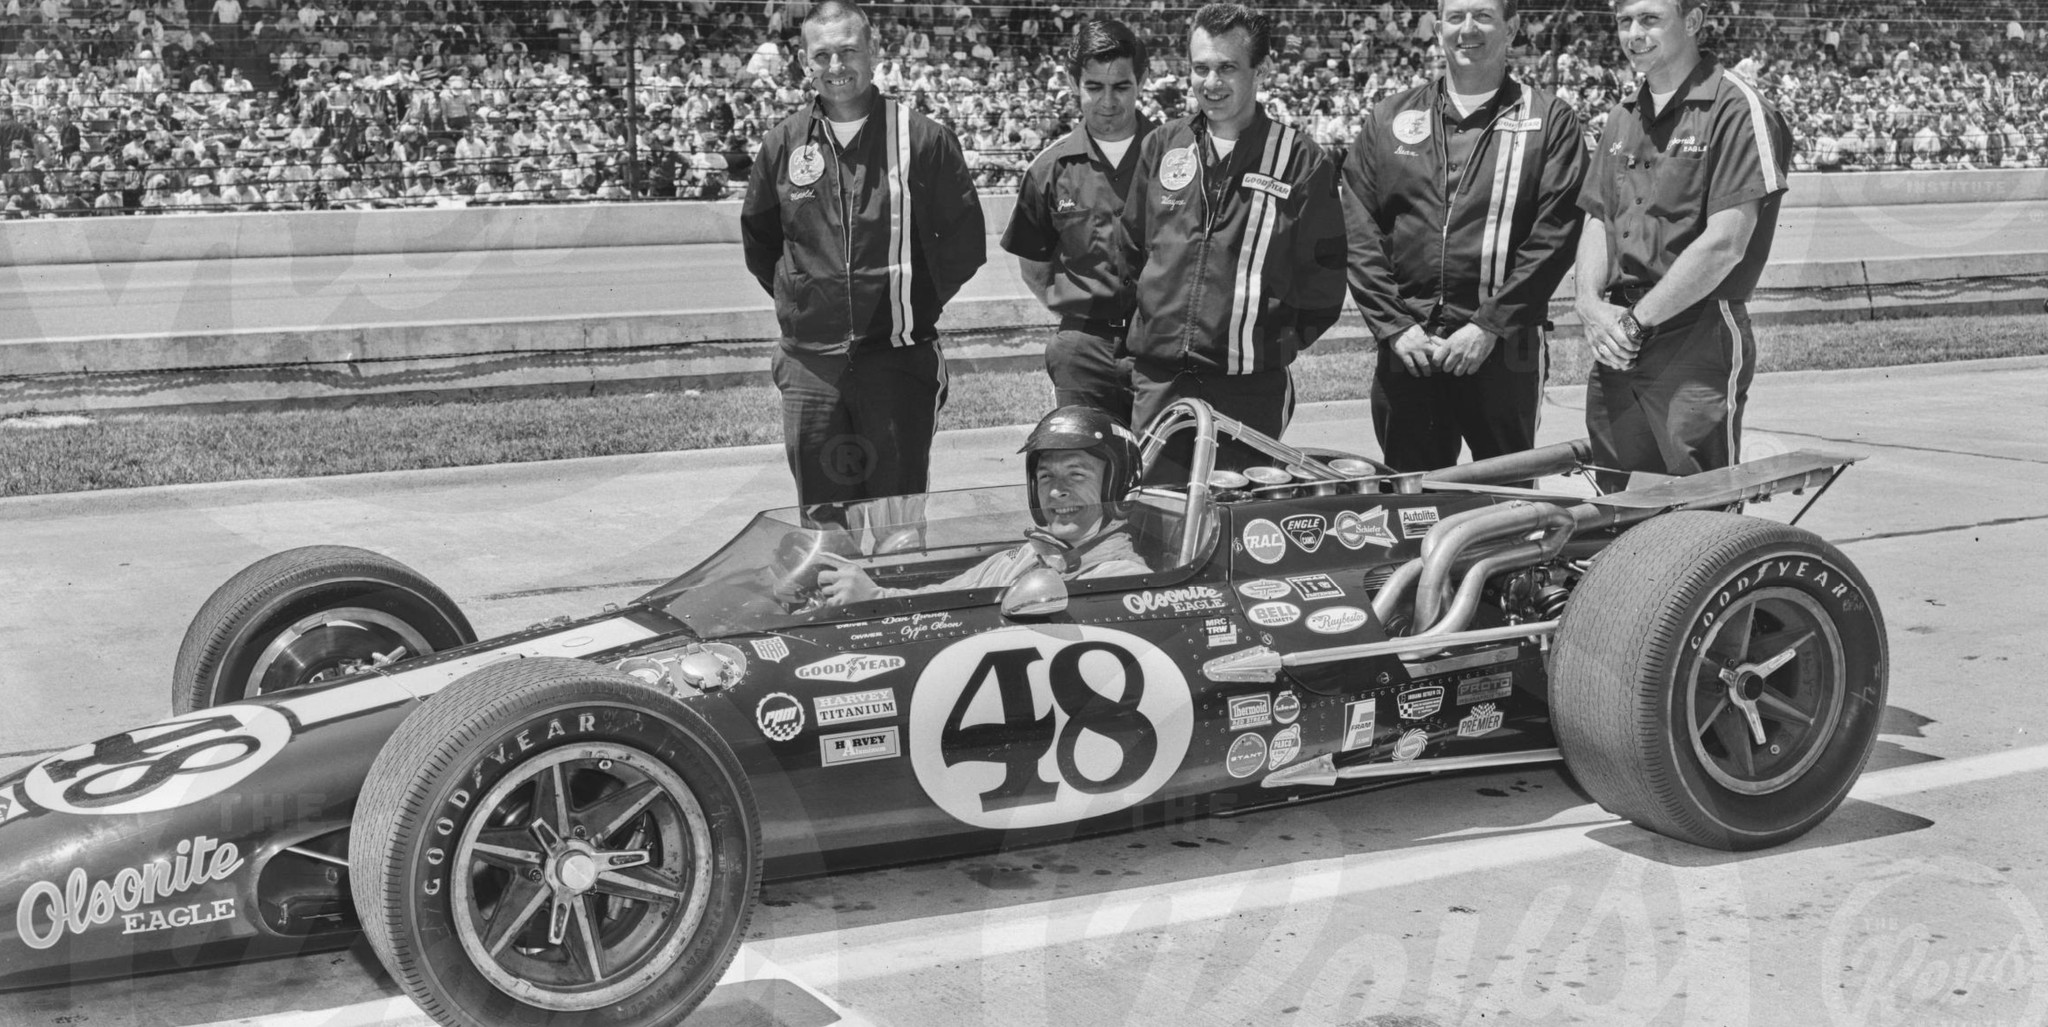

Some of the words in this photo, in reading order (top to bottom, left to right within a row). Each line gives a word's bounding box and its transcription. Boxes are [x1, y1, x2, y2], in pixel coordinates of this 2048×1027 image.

[1286, 517, 1321, 530] ENGLE
[1402, 509, 1437, 523] Autolite
[1122, 585, 1224, 615] Olsonite
[1170, 598, 1230, 613] EAGLE
[1255, 604, 1298, 621] BELL
[1262, 616, 1295, 625] HELMETS
[1318, 609, 1365, 630] Raybestos
[1205, 617, 1228, 627] MRC
[1206, 626, 1229, 635] TRW
[1460, 678, 1511, 696] PROTO
[819, 690, 891, 706] HARVEY
[1275, 702, 1298, 711] ideal
[763, 706, 798, 727] rpm
[819, 702, 895, 721] TITANIUM
[1232, 699, 1268, 718] Thermoid
[940, 640, 1159, 813] 48
[1351, 720, 1373, 732] FRAM
[1460, 714, 1500, 735] PREMIER
[41, 713, 262, 809] 48
[1230, 751, 1263, 762] STANT
[16, 835, 245, 950] Olsonite
[121, 897, 237, 935] EAGLE
